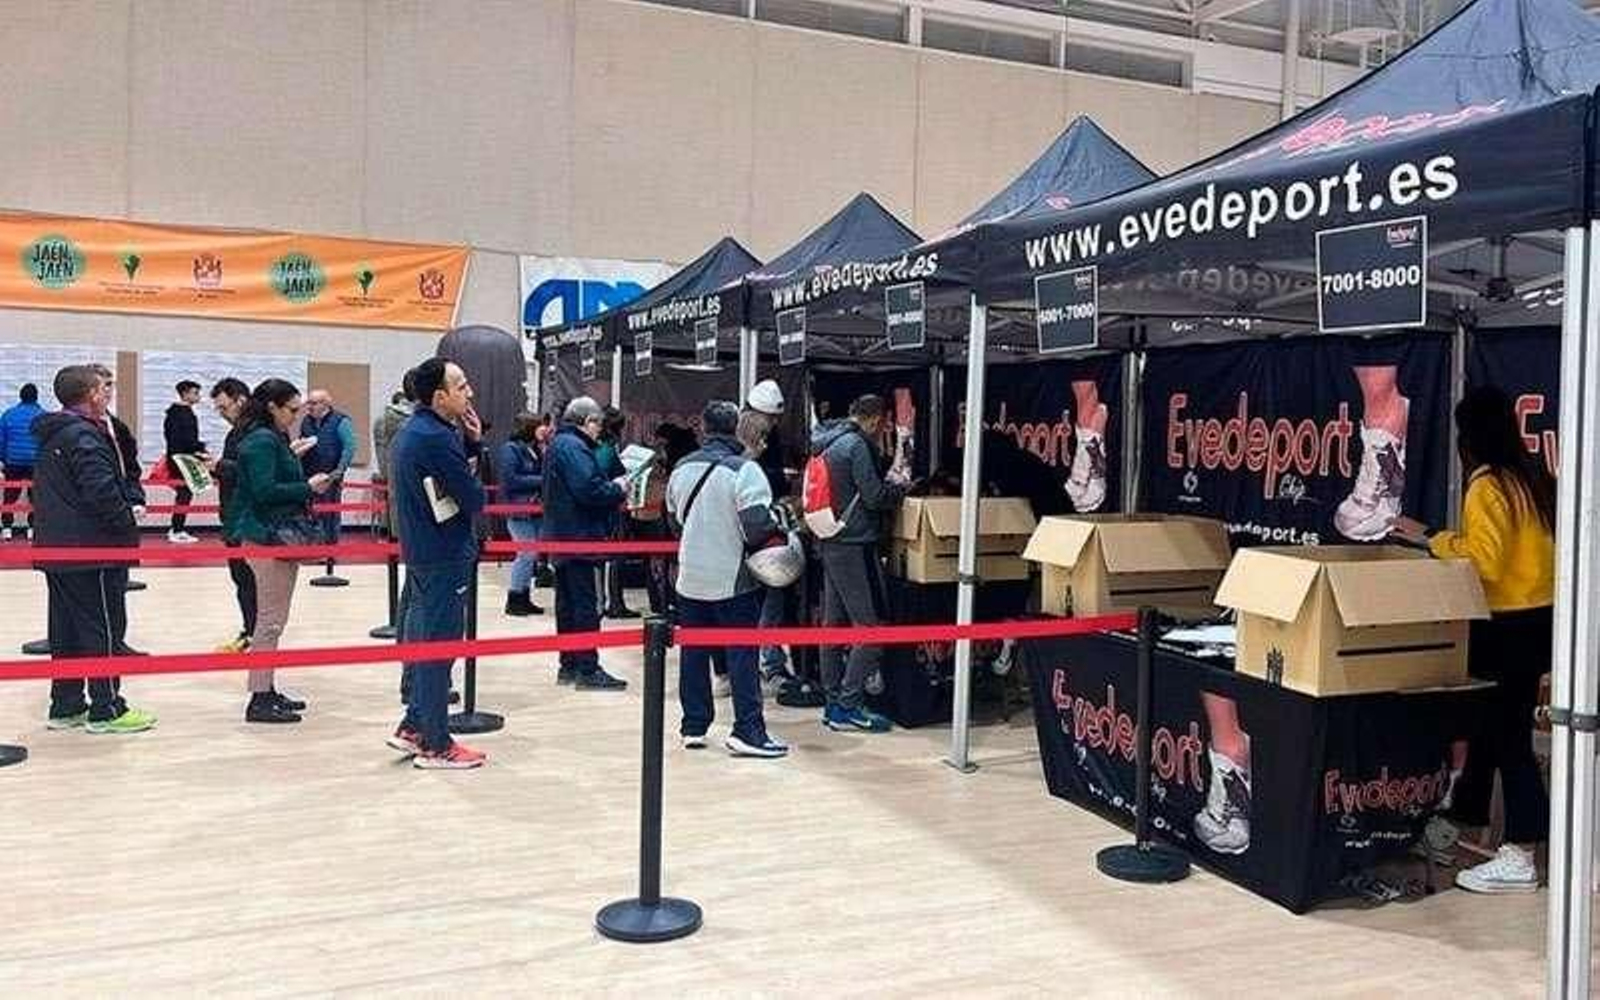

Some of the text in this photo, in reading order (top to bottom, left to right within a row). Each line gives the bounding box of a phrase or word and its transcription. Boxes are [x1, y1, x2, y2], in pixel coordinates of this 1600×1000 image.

[1024, 154, 1459, 269] www.evedeport.es
[771, 252, 939, 311] www.evedeport.es
[1322, 265, 1421, 294] 7001-8000
[1167, 391, 1354, 500] Evedeport
